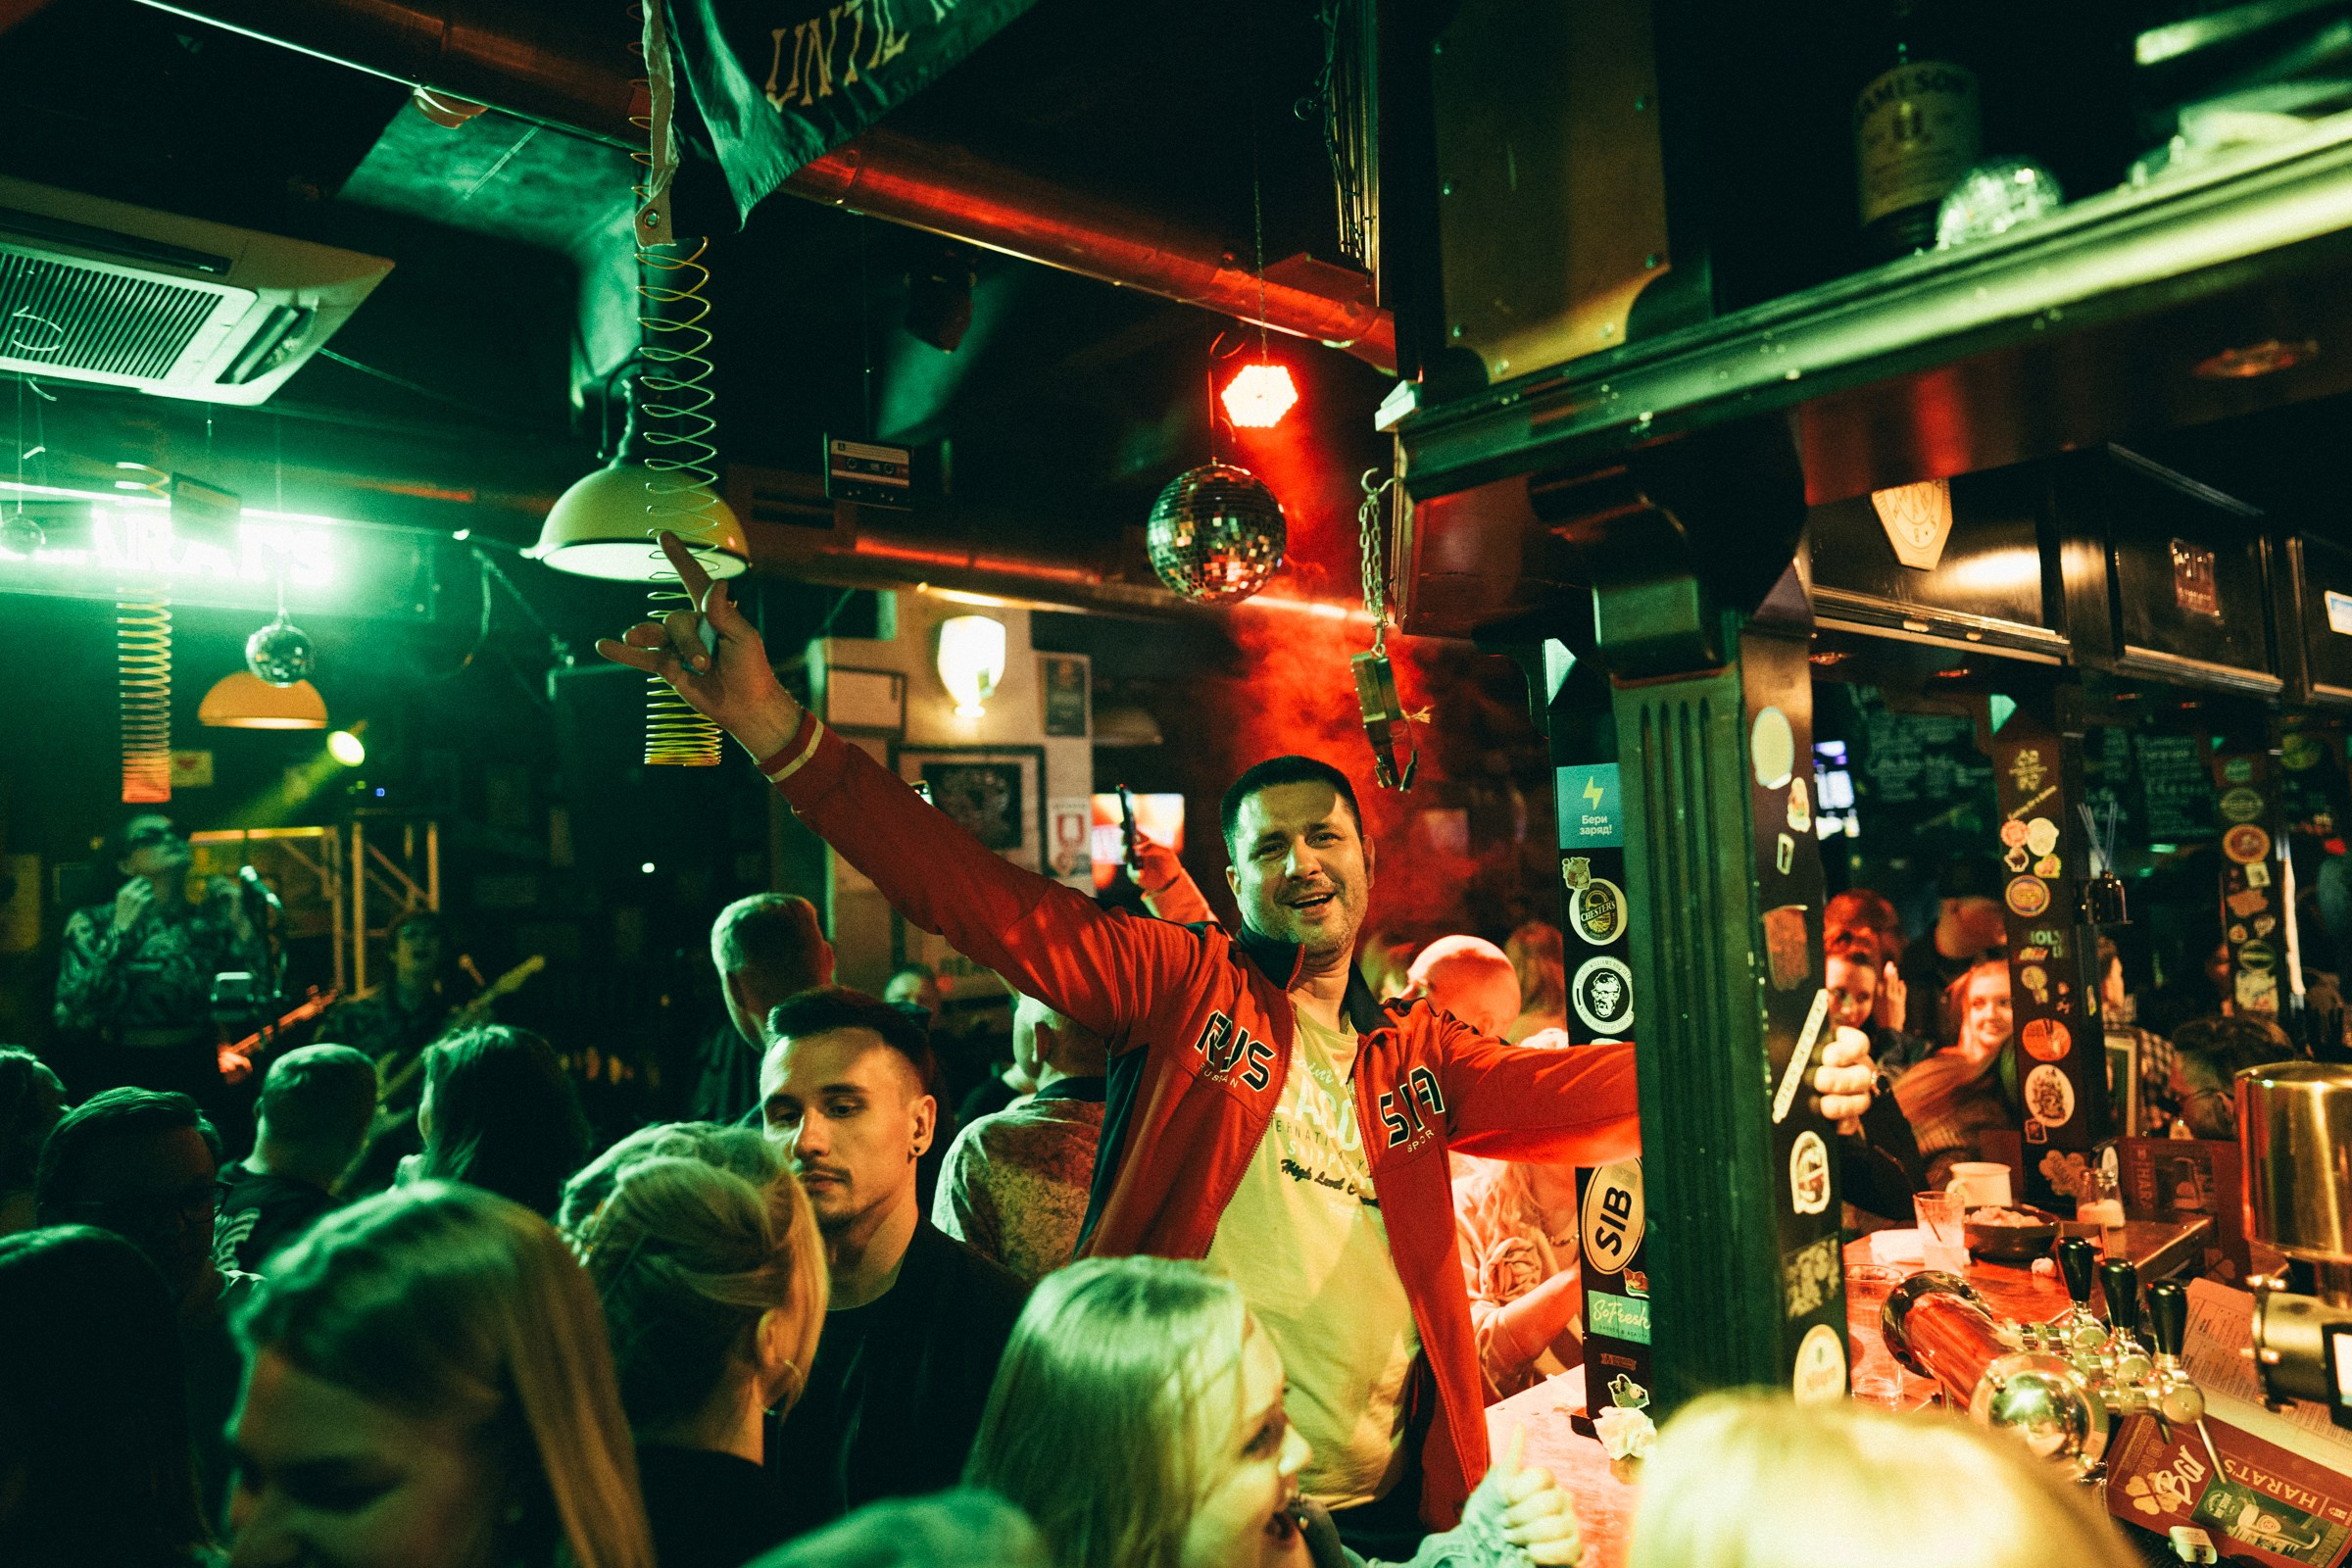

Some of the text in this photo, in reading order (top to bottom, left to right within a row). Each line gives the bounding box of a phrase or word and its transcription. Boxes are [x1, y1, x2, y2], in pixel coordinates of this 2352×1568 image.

[765, 0, 910, 114] UNTIL
[1580, 825, 1612, 837] заряд!
[1582, 815, 1608, 826] Бери
[1194, 1009, 1277, 1093] RUS
[1378, 1065, 1446, 1149] SIA
[1595, 1187, 1632, 1257] SIB
[2155, 1445, 2207, 1506] Bar
[2223, 1457, 2320, 1510] HARAT'S
